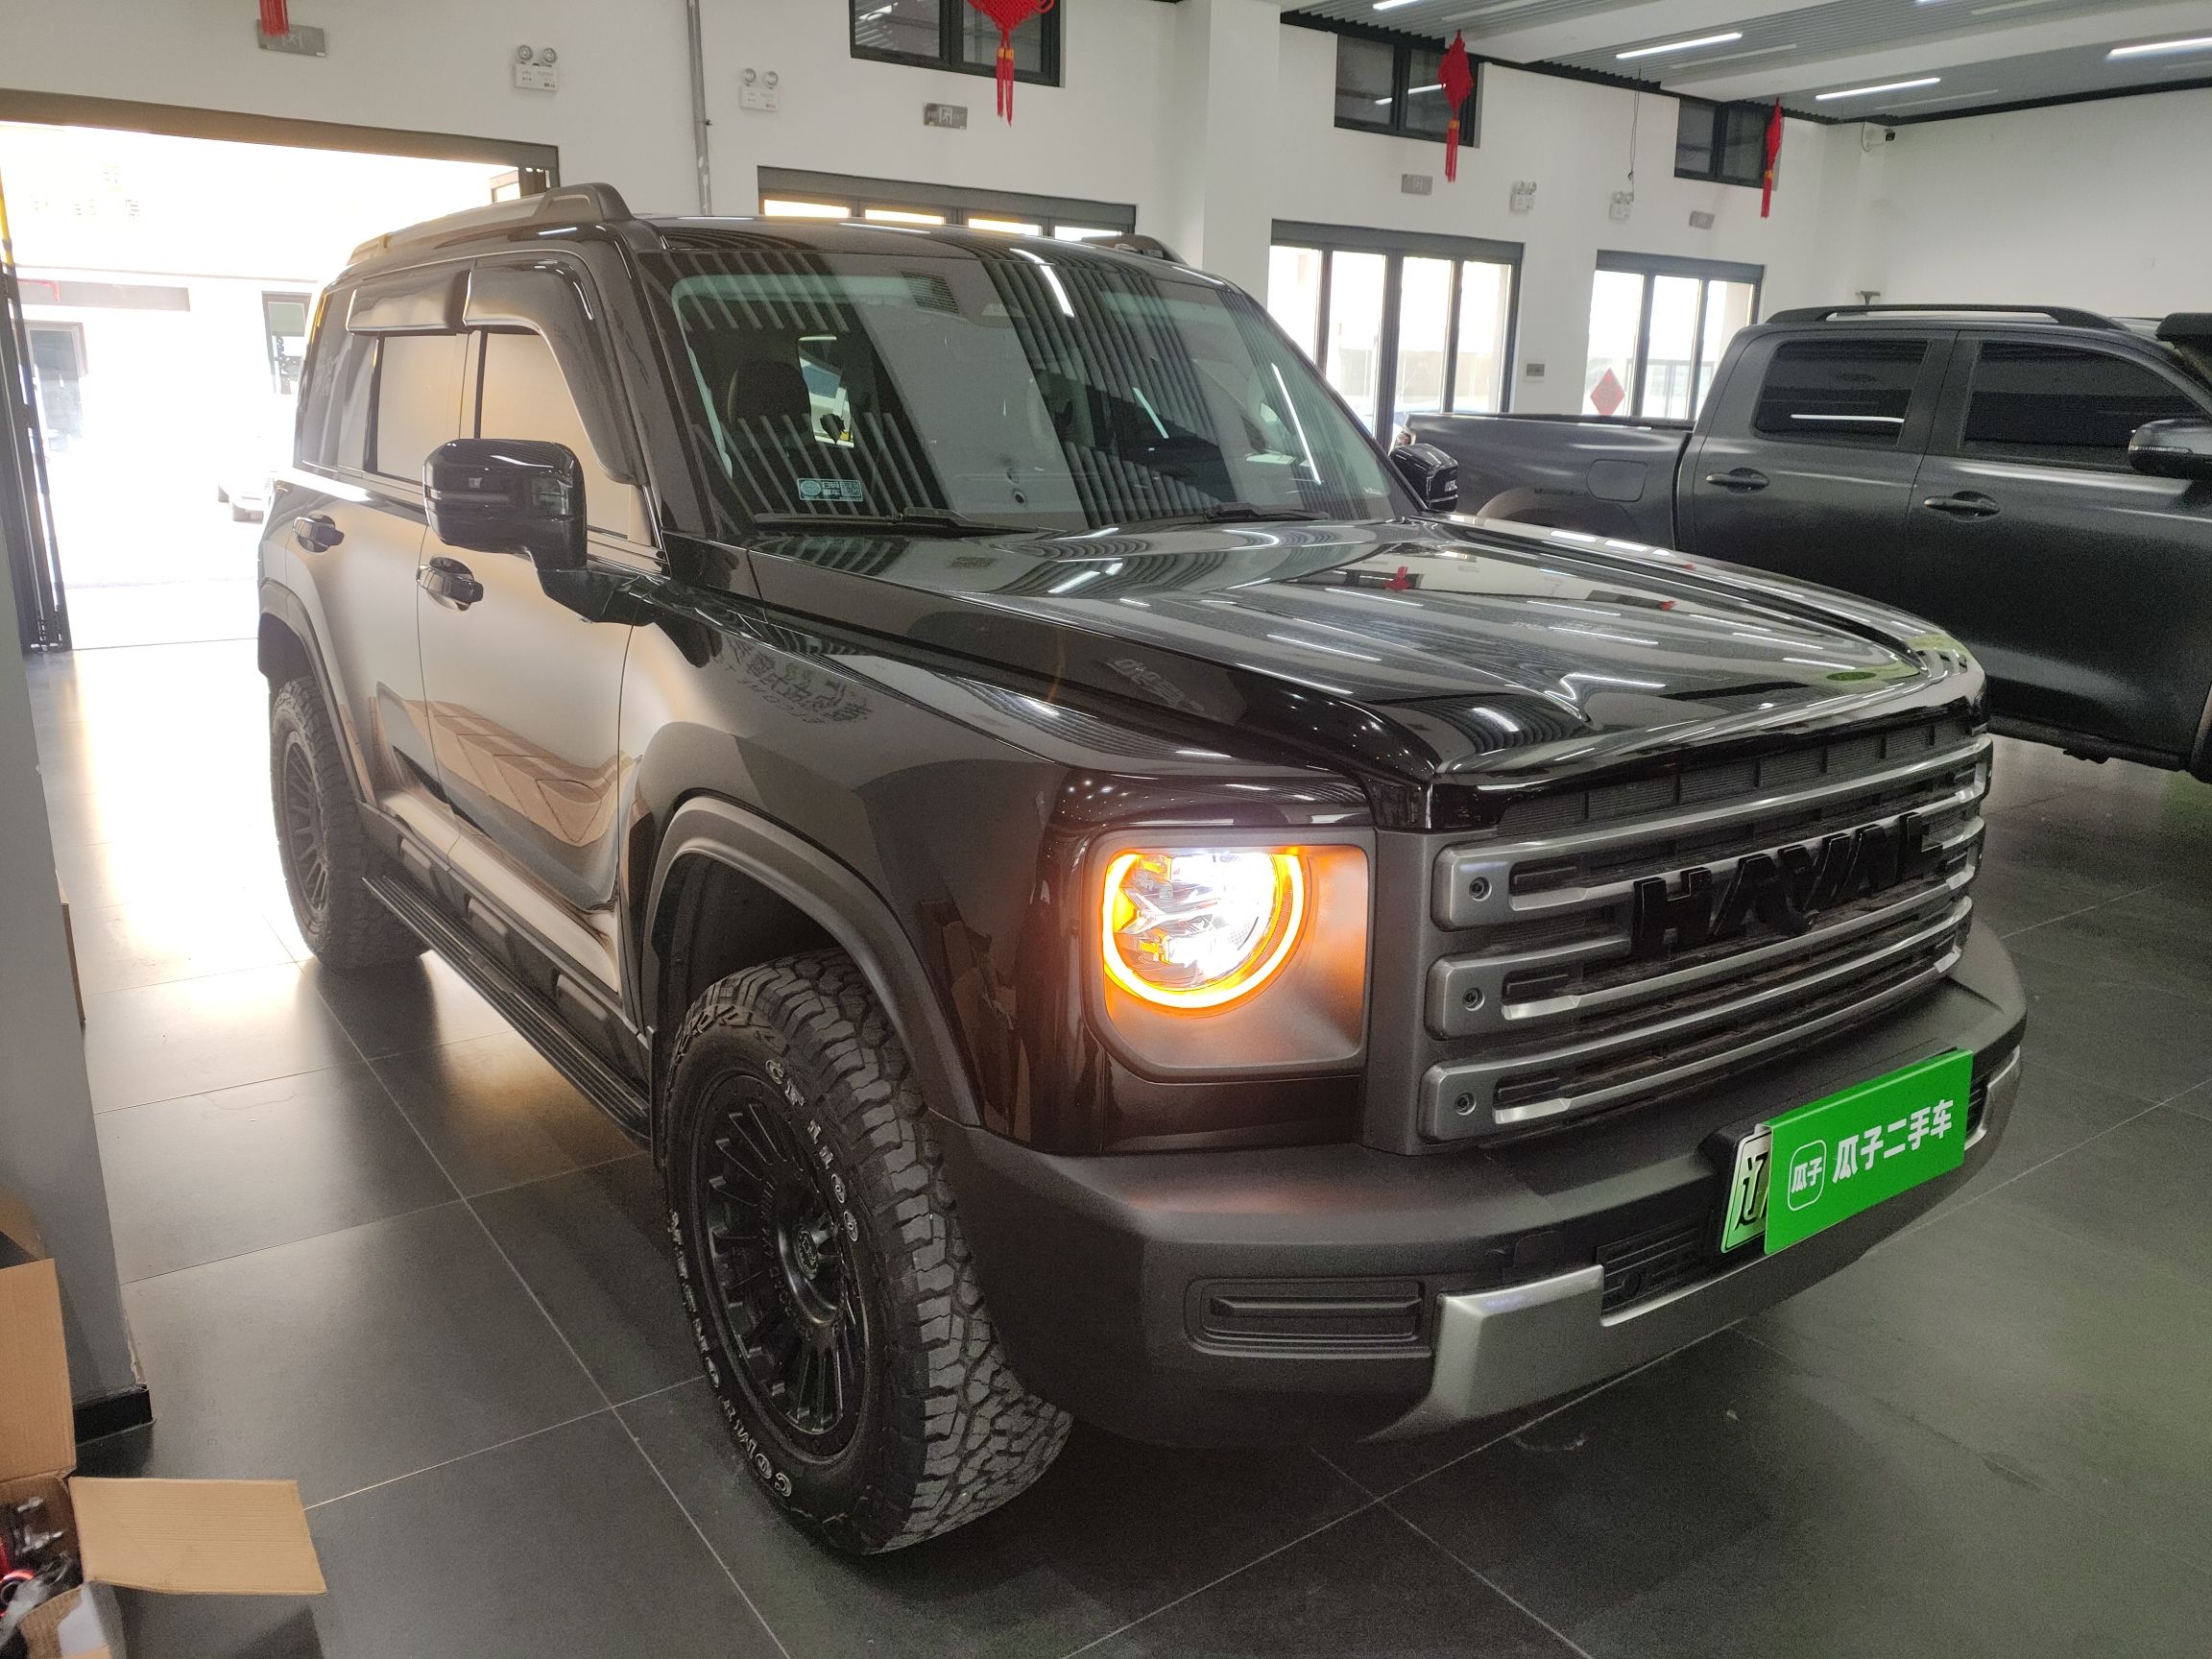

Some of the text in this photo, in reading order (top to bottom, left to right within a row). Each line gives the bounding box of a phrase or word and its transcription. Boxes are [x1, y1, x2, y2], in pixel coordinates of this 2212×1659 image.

[1632, 812, 1943, 960] HAVAL
[1791, 1156, 1823, 1193] 瓜子
[1832, 1098, 1954, 1184] 瓜子二手车
[1734, 1151, 1768, 1230] 辽
